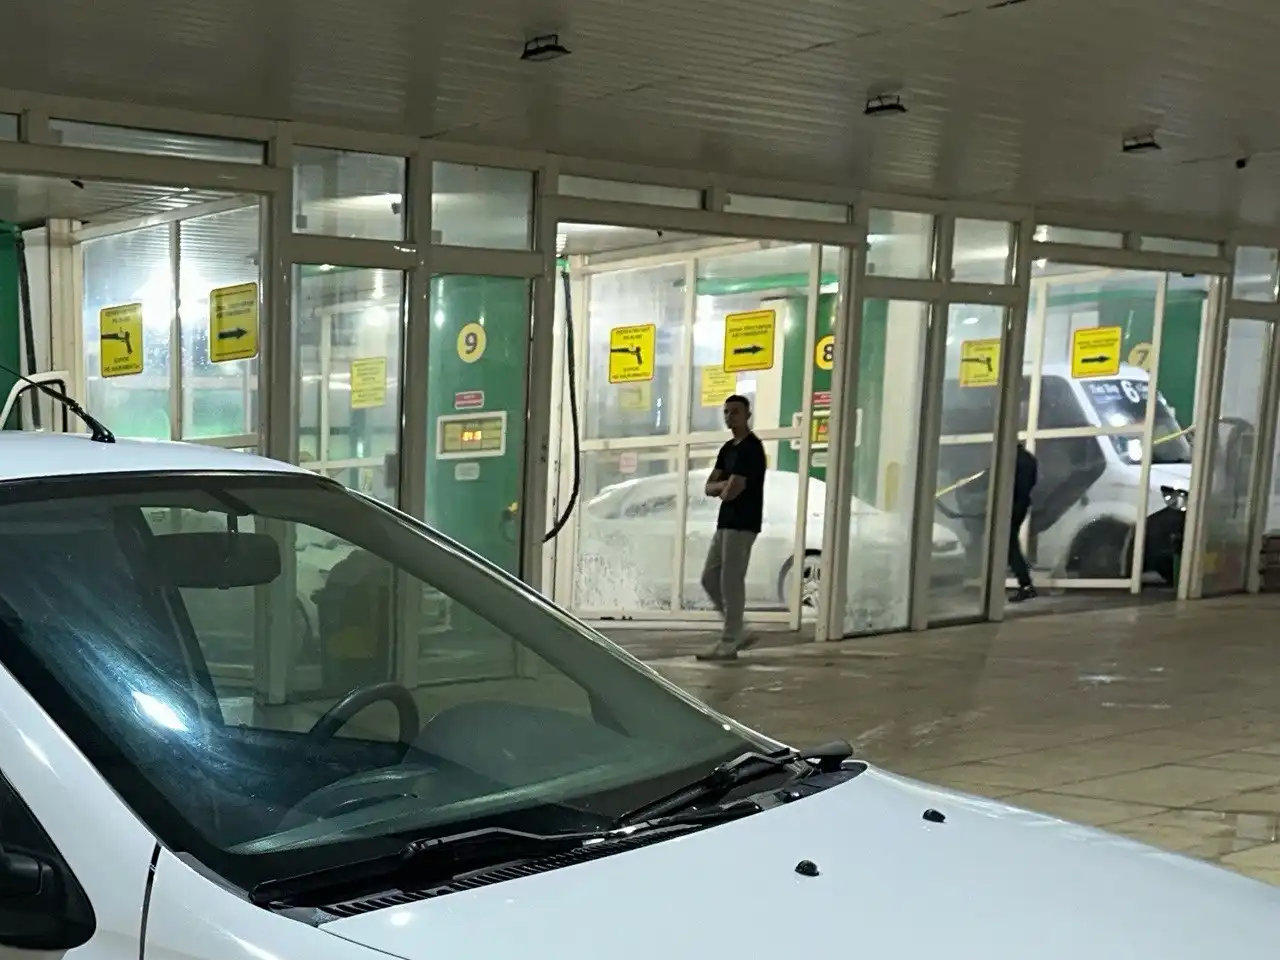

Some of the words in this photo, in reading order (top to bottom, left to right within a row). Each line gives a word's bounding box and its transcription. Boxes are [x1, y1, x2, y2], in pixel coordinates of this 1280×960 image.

[465, 332, 477, 354] 9
[823, 344, 834, 362] 8
[1136, 350, 1149, 366] 7
[1121, 380, 1140, 403] 6
